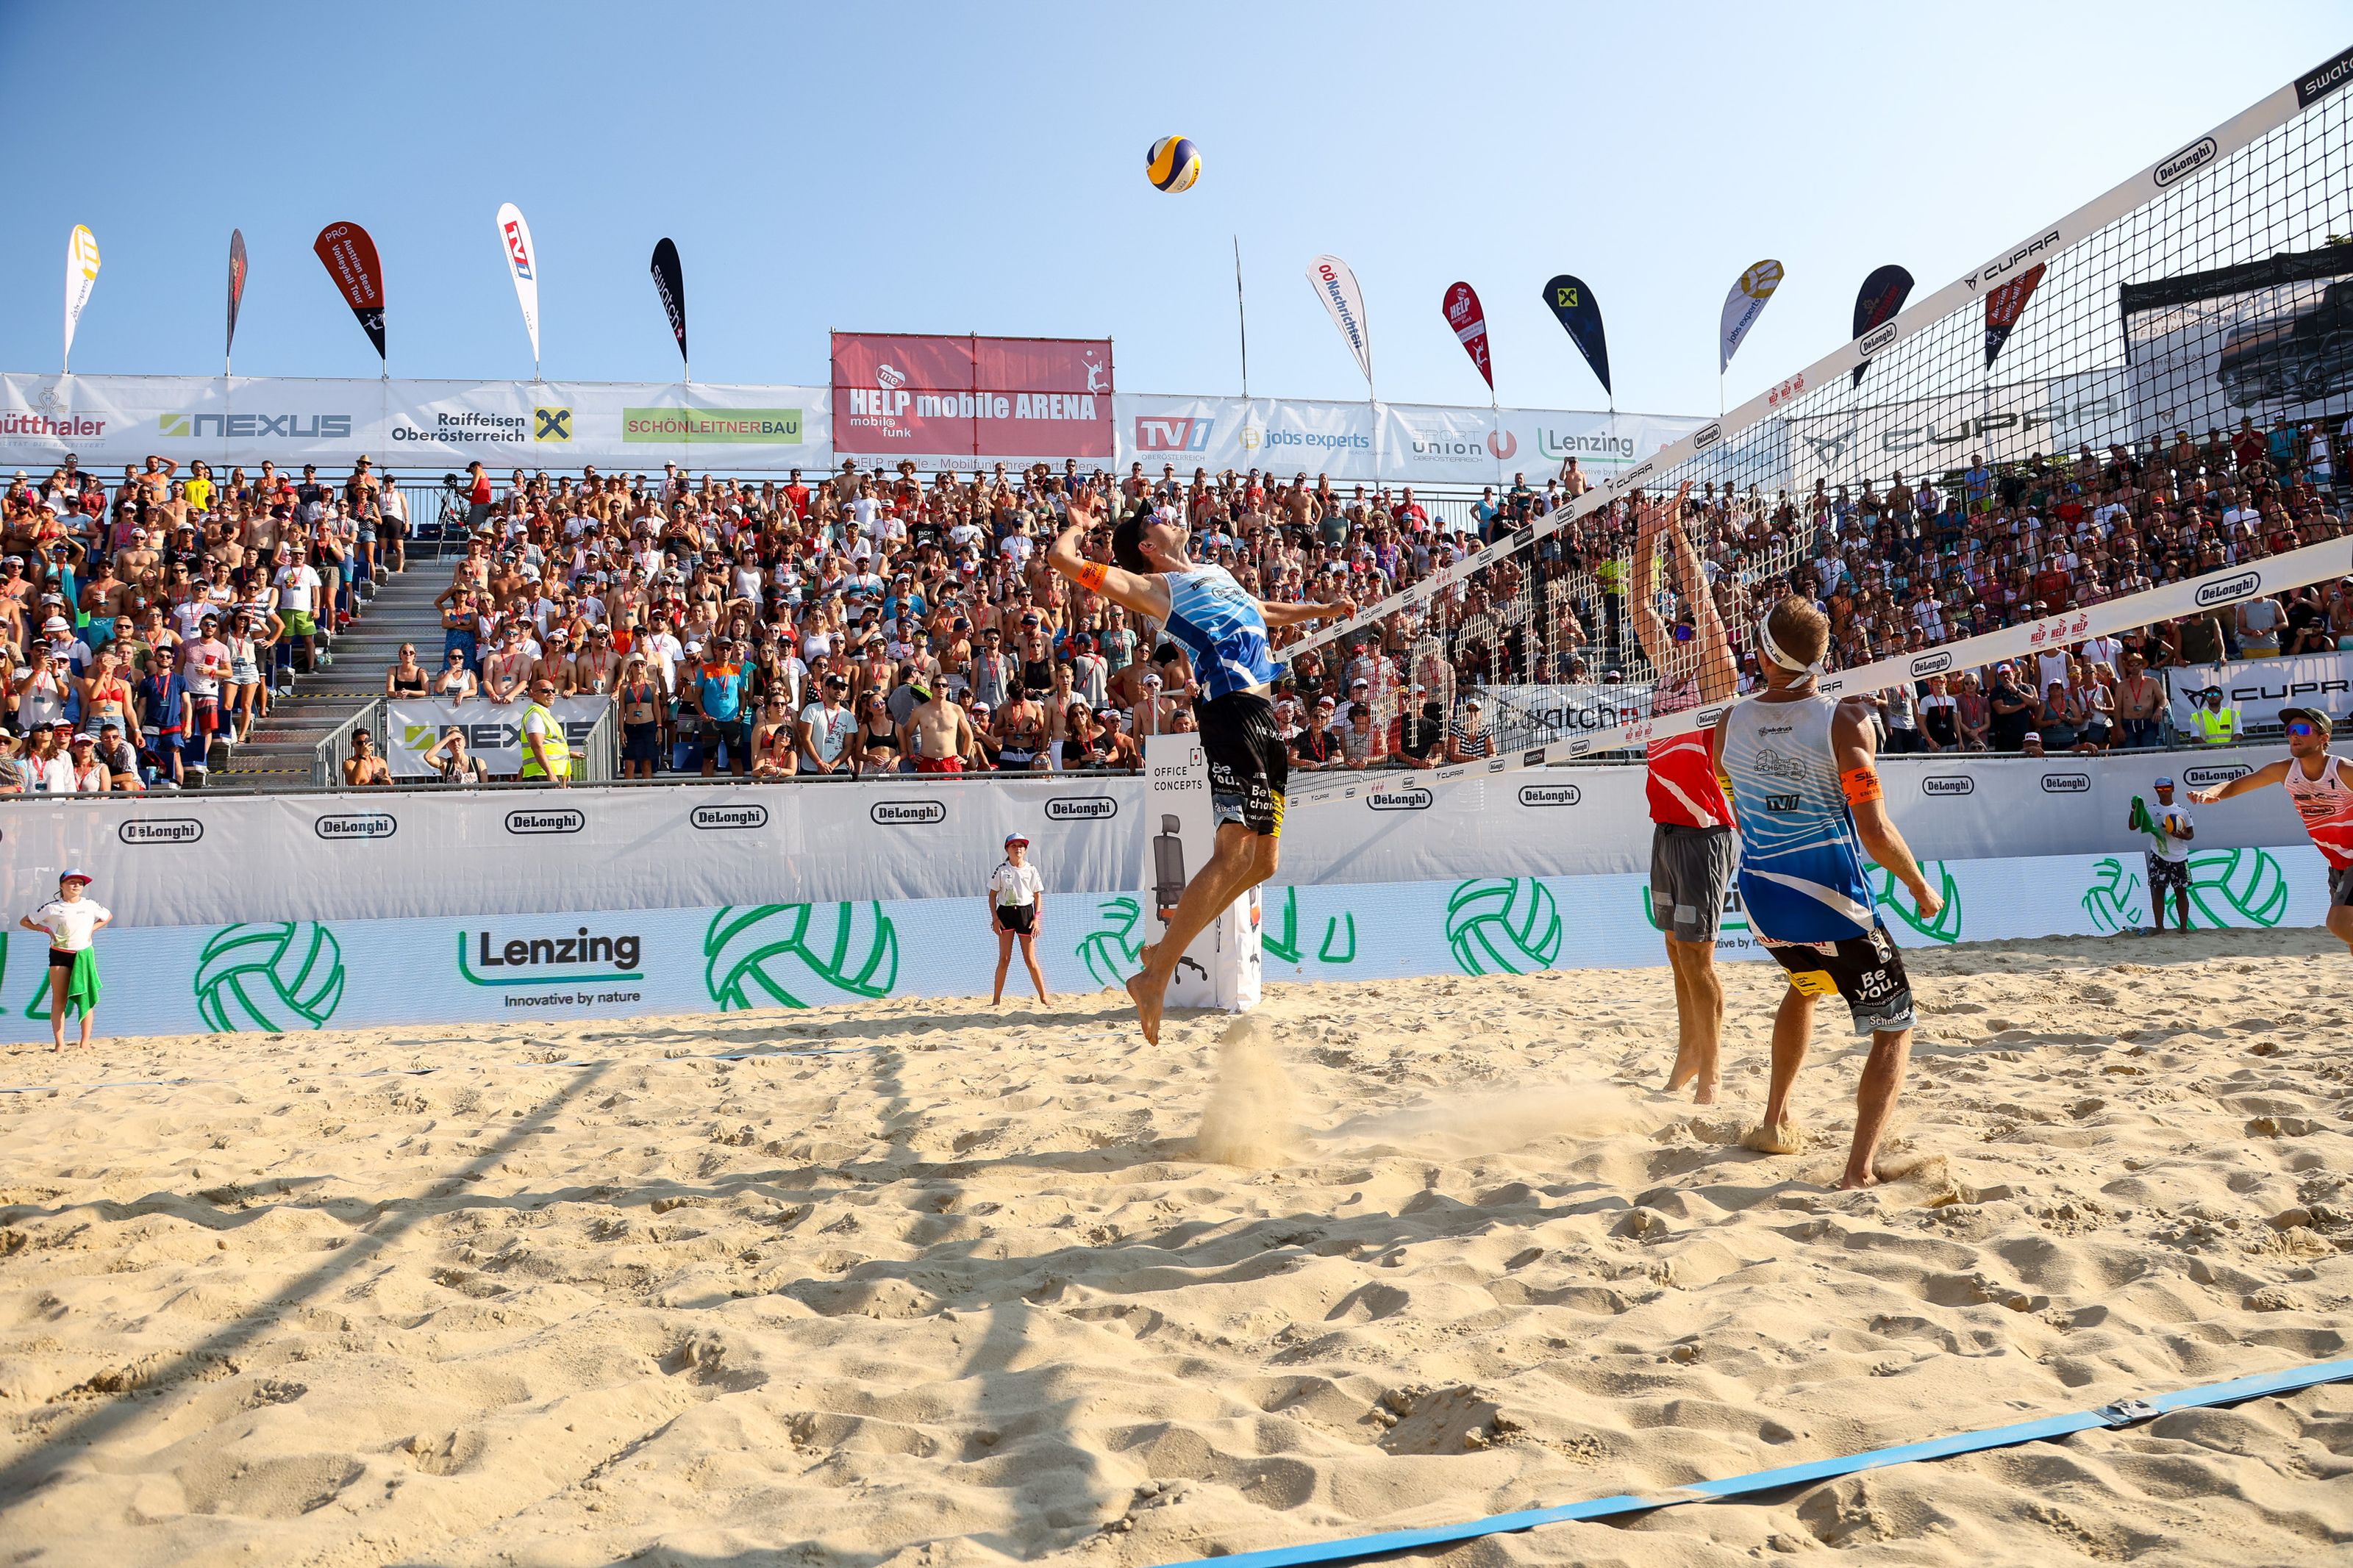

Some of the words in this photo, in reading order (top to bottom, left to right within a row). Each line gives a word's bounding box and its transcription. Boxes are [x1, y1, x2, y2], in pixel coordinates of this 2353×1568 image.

[325, 226, 348, 242] PRO
[1984, 230, 2060, 280] CUPRA
[331, 245, 356, 285] Volleyball
[349, 284, 364, 304] Tour
[343, 239, 364, 273] Austrian
[359, 271, 375, 299] Beach
[652, 265, 680, 330] swatch
[1318, 265, 1363, 349] OÖNachrichten
[1450, 297, 1471, 320] HELP
[1727, 326, 1742, 345] jobs
[1739, 298, 1761, 328] experts
[879, 370, 899, 386] me
[850, 388, 910, 416] HELP
[917, 392, 1010, 419] mobile
[1015, 393, 1096, 420] ARENA
[438, 412, 525, 426] Raiffeisen
[628, 418, 798, 435] SCHÖNLEITNERBAU
[850, 417, 896, 428] mobile
[392, 427, 525, 442] Oberösterreich
[882, 427, 912, 437] funk
[1140, 420, 1208, 447] TV1
[1264, 429, 1302, 448] jobs
[1306, 432, 1369, 450] experts
[1411, 429, 1480, 442] SPORT
[1550, 429, 1634, 458] Lenzing
[852, 457, 883, 468] HELP
[888, 458, 928, 469] mile
[1141, 454, 1205, 462] OBERÖSTERREICH
[1413, 455, 1483, 463] OBERÖSTERREICH
[1616, 463, 1653, 489] CUPRA
[2030, 630, 2046, 643] HELP
[2050, 626, 2067, 639] HELP
[2071, 620, 2088, 634] HELP
[2231, 679, 2353, 701] CUPR
[439, 721, 596, 749] NEXS
[1154, 766, 1187, 777] OFFICE
[1212, 762, 1232, 775] Be
[1154, 780, 1202, 791] CONCEPTS
[1252, 785, 1267, 797] Be
[2328, 778, 2335, 790] 1
[480, 926, 640, 970] Lenzing
[1738, 937, 1750, 949] by
[1854, 977, 1899, 1001] you.
[1861, 969, 1887, 989] Be
[505, 993, 574, 1008] Innovative
[577, 992, 592, 1007] by
[597, 990, 640, 1003] nature
[1869, 1007, 1911, 1027] Schnetzer
